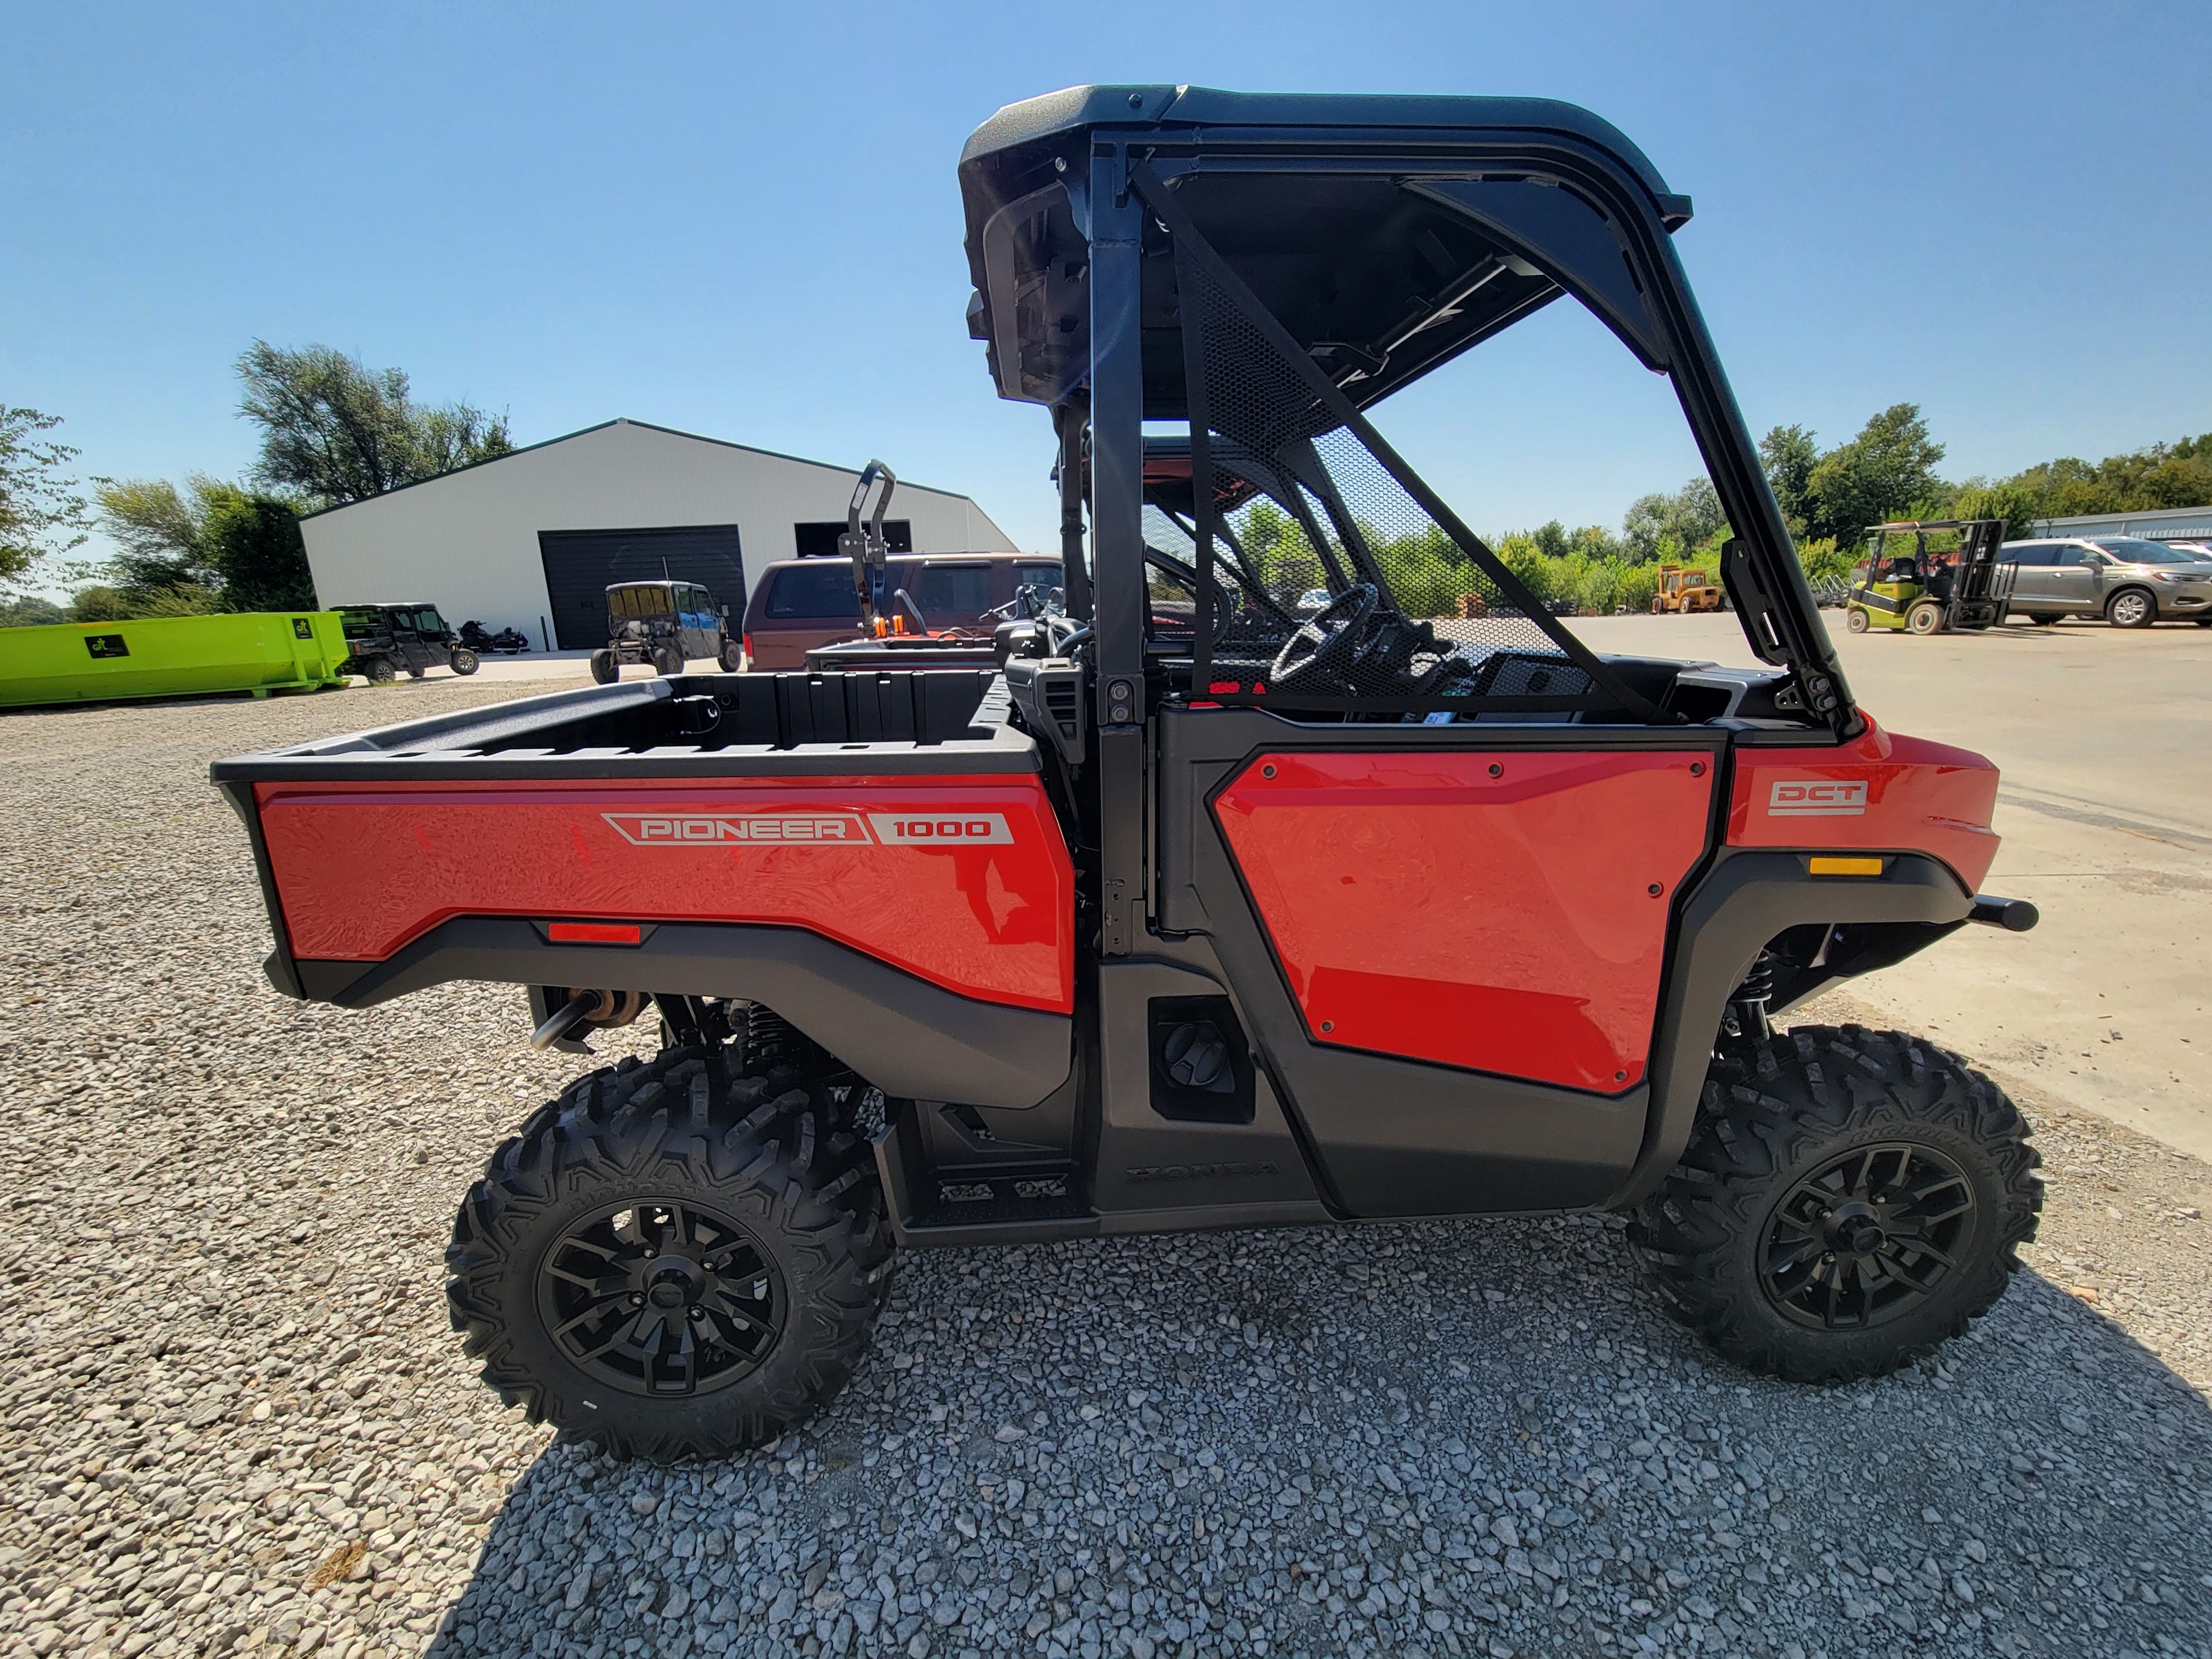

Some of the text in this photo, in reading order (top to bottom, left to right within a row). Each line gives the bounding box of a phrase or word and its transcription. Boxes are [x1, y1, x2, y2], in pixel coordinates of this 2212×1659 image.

[1778, 786, 1861, 802] DCT
[641, 820, 992, 839] PIONEER 1000
[1125, 1160, 1282, 1183] HONDA
